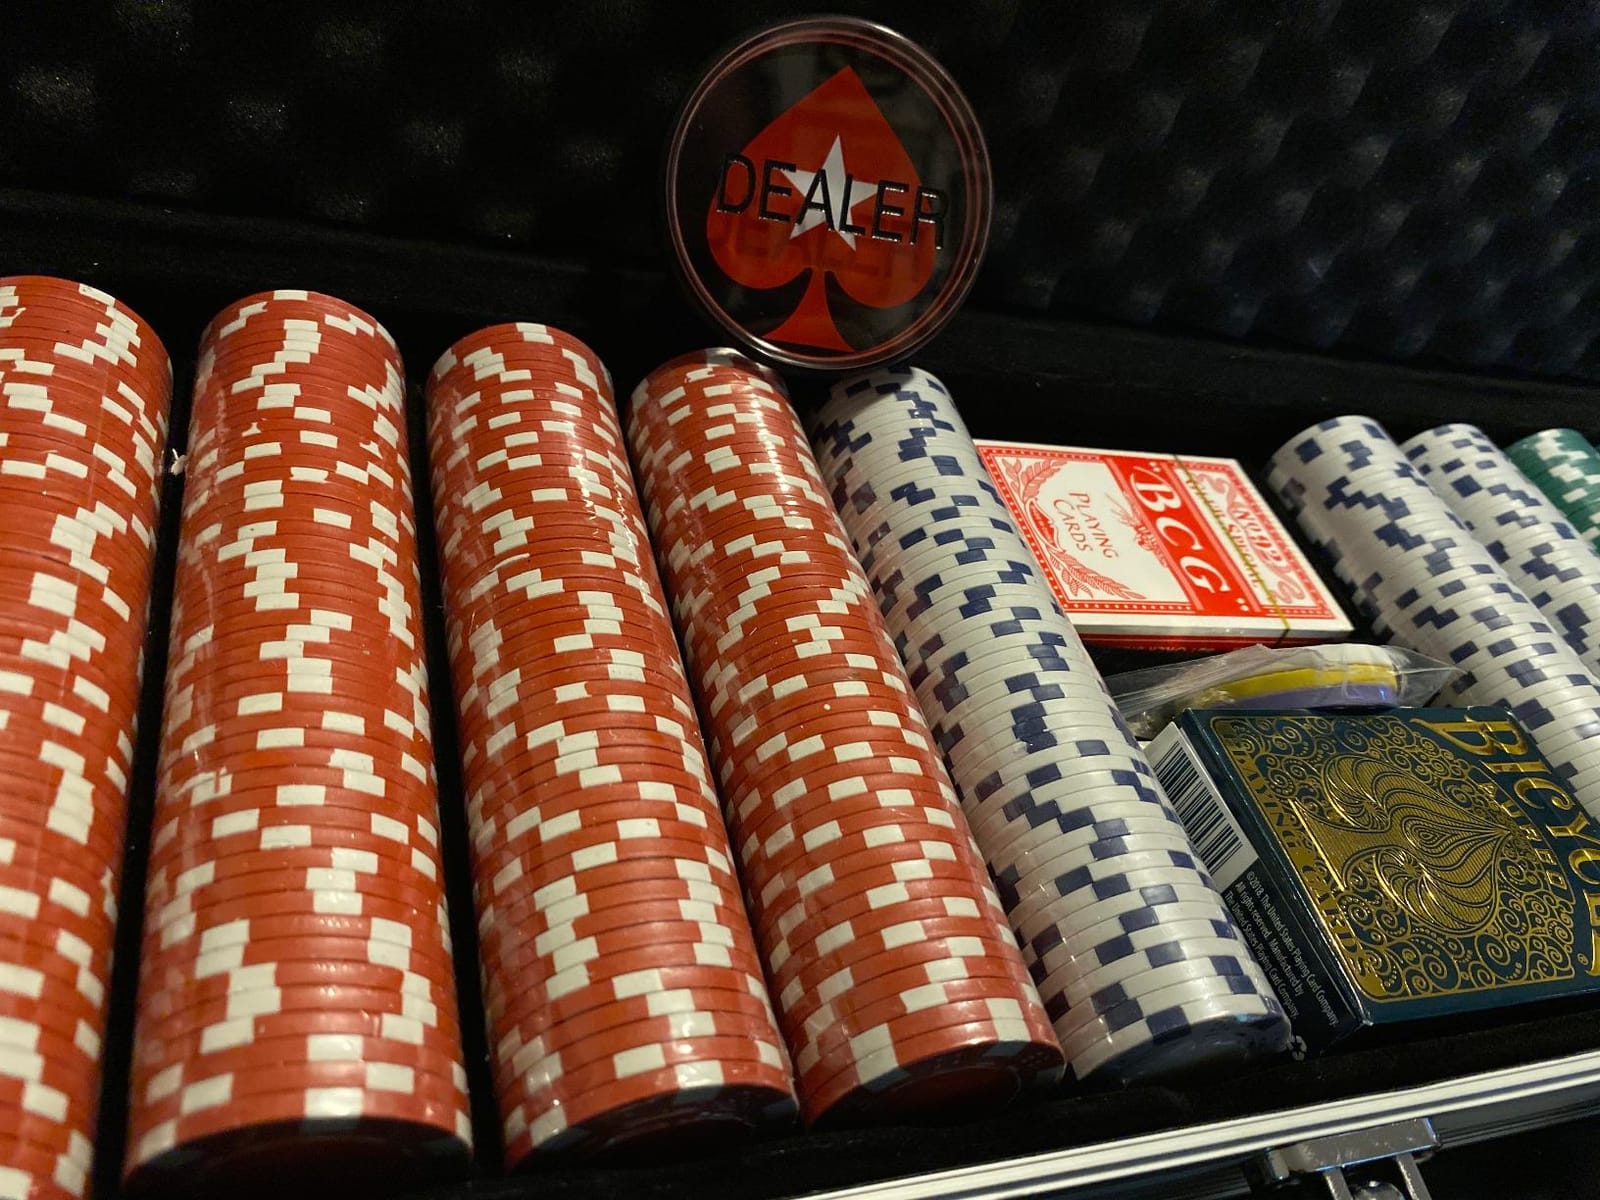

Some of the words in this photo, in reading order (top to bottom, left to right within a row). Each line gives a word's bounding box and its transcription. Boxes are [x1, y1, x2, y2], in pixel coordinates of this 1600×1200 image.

[716, 152, 949, 251] DEALER
[1053, 499, 1094, 551] CARDS
[1068, 492, 1119, 559] PLAYING
[1410, 714, 1600, 977] BICYC
[1267, 905, 1285, 931] United
[1279, 928, 1295, 951] States
[1291, 948, 1309, 977] Playing
[1306, 974, 1321, 992] Card
[1302, 864, 1368, 977] CARDS
